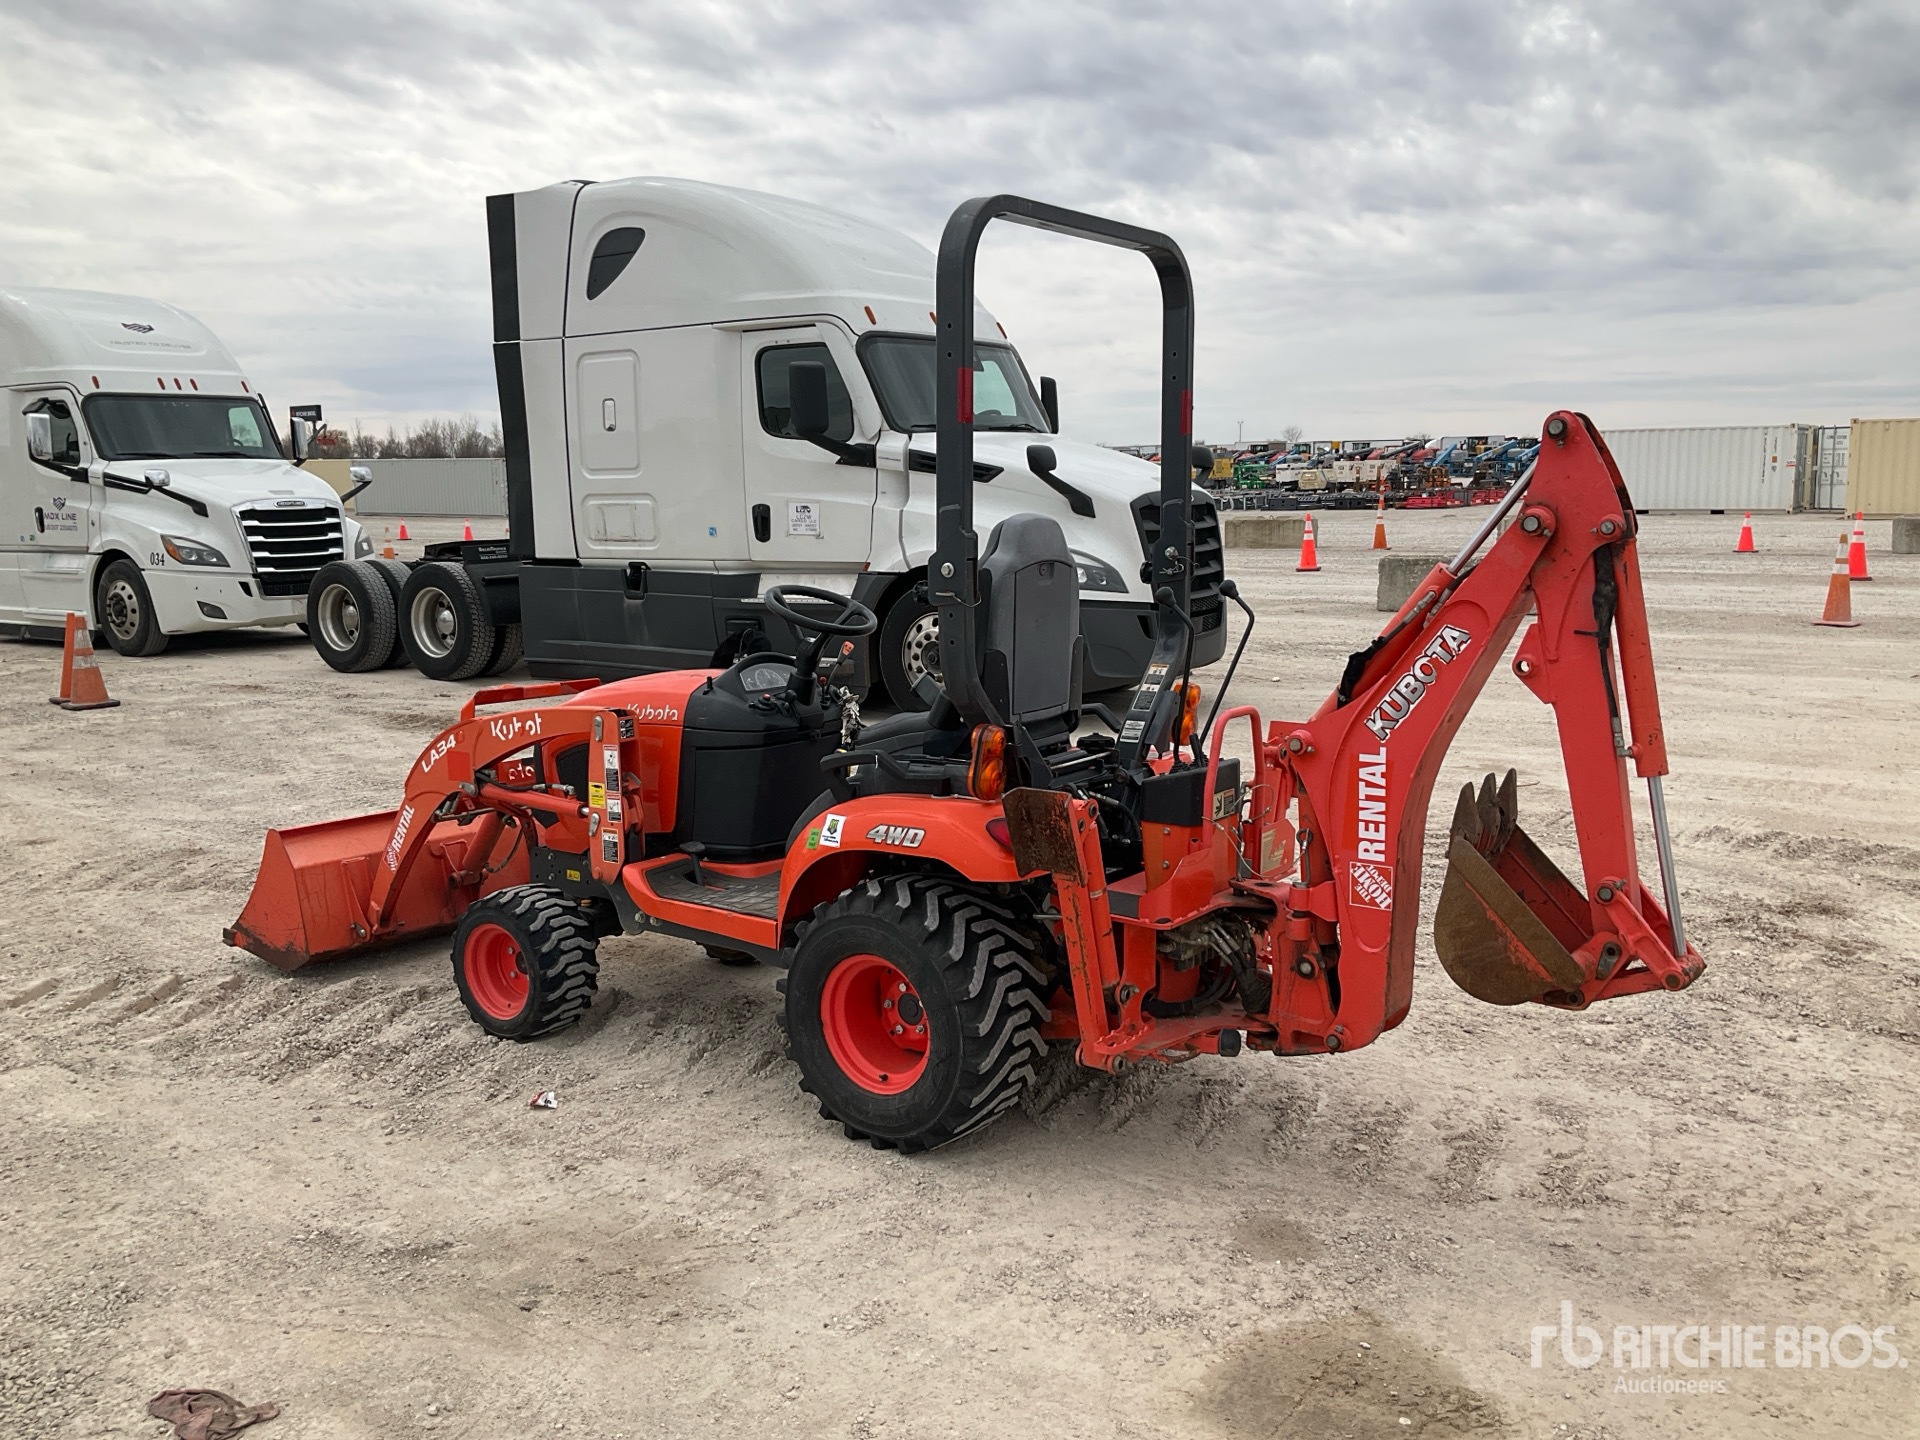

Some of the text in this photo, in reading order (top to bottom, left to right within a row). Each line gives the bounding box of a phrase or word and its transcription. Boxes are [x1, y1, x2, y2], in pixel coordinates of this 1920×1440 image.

[61, 513, 77, 521] LINE
[150, 552, 165, 566] 034
[1365, 624, 1472, 742] KUBOTA
[1358, 747, 1387, 862] RENTAL
[391, 804, 415, 853] RENTAL
[866, 824, 926, 848] 4WD
[1350, 862, 1392, 909] HOME
[1366, 865, 1392, 892] DEPOT
[1354, 882, 1371, 903] THE
